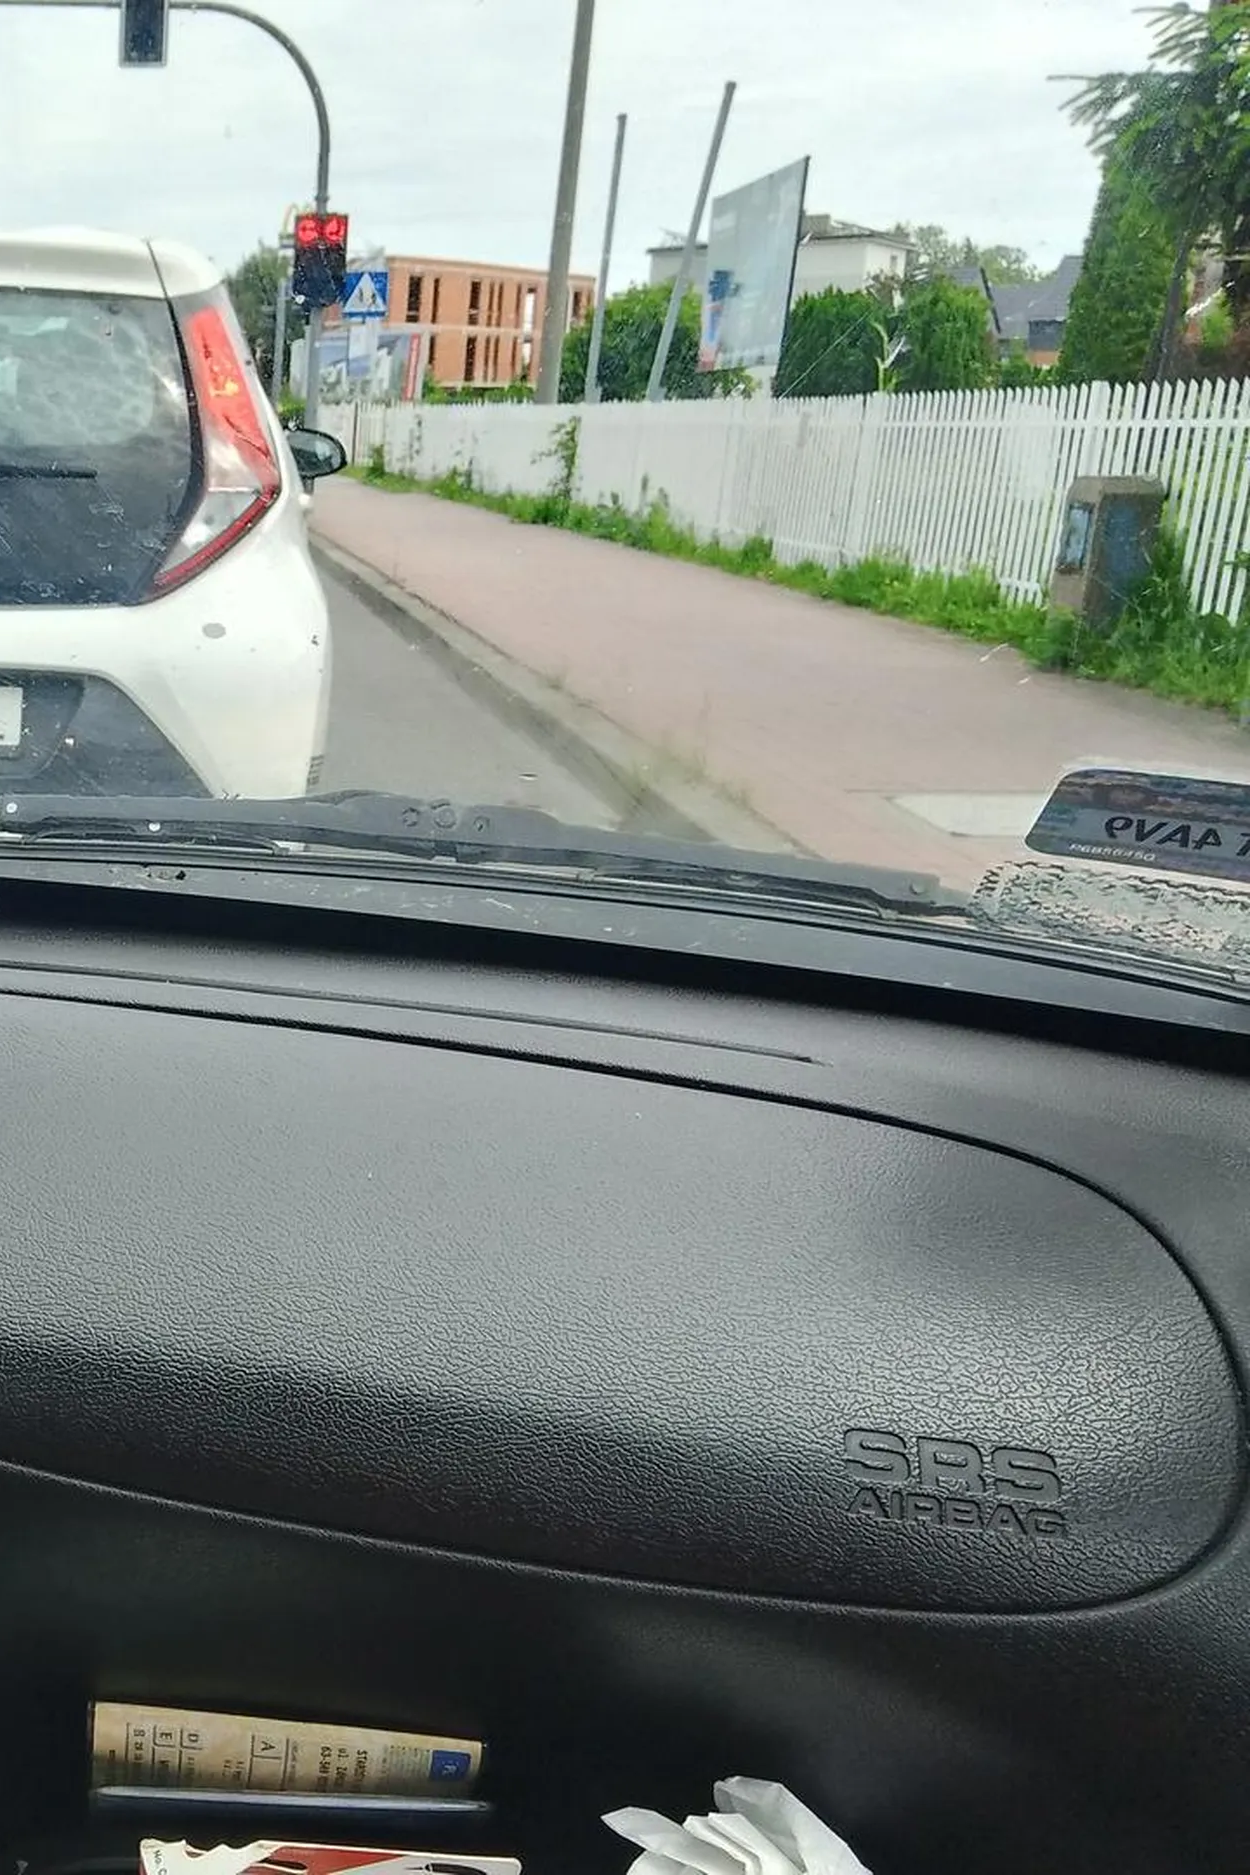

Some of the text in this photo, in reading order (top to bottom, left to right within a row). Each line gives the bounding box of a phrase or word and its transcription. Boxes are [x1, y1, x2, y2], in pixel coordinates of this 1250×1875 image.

[843, 1427, 1063, 1502] SRS
[847, 1486, 1067, 1539] AIRBAG
[186, 1732, 200, 1743] D
[259, 1740, 275, 1752] A
